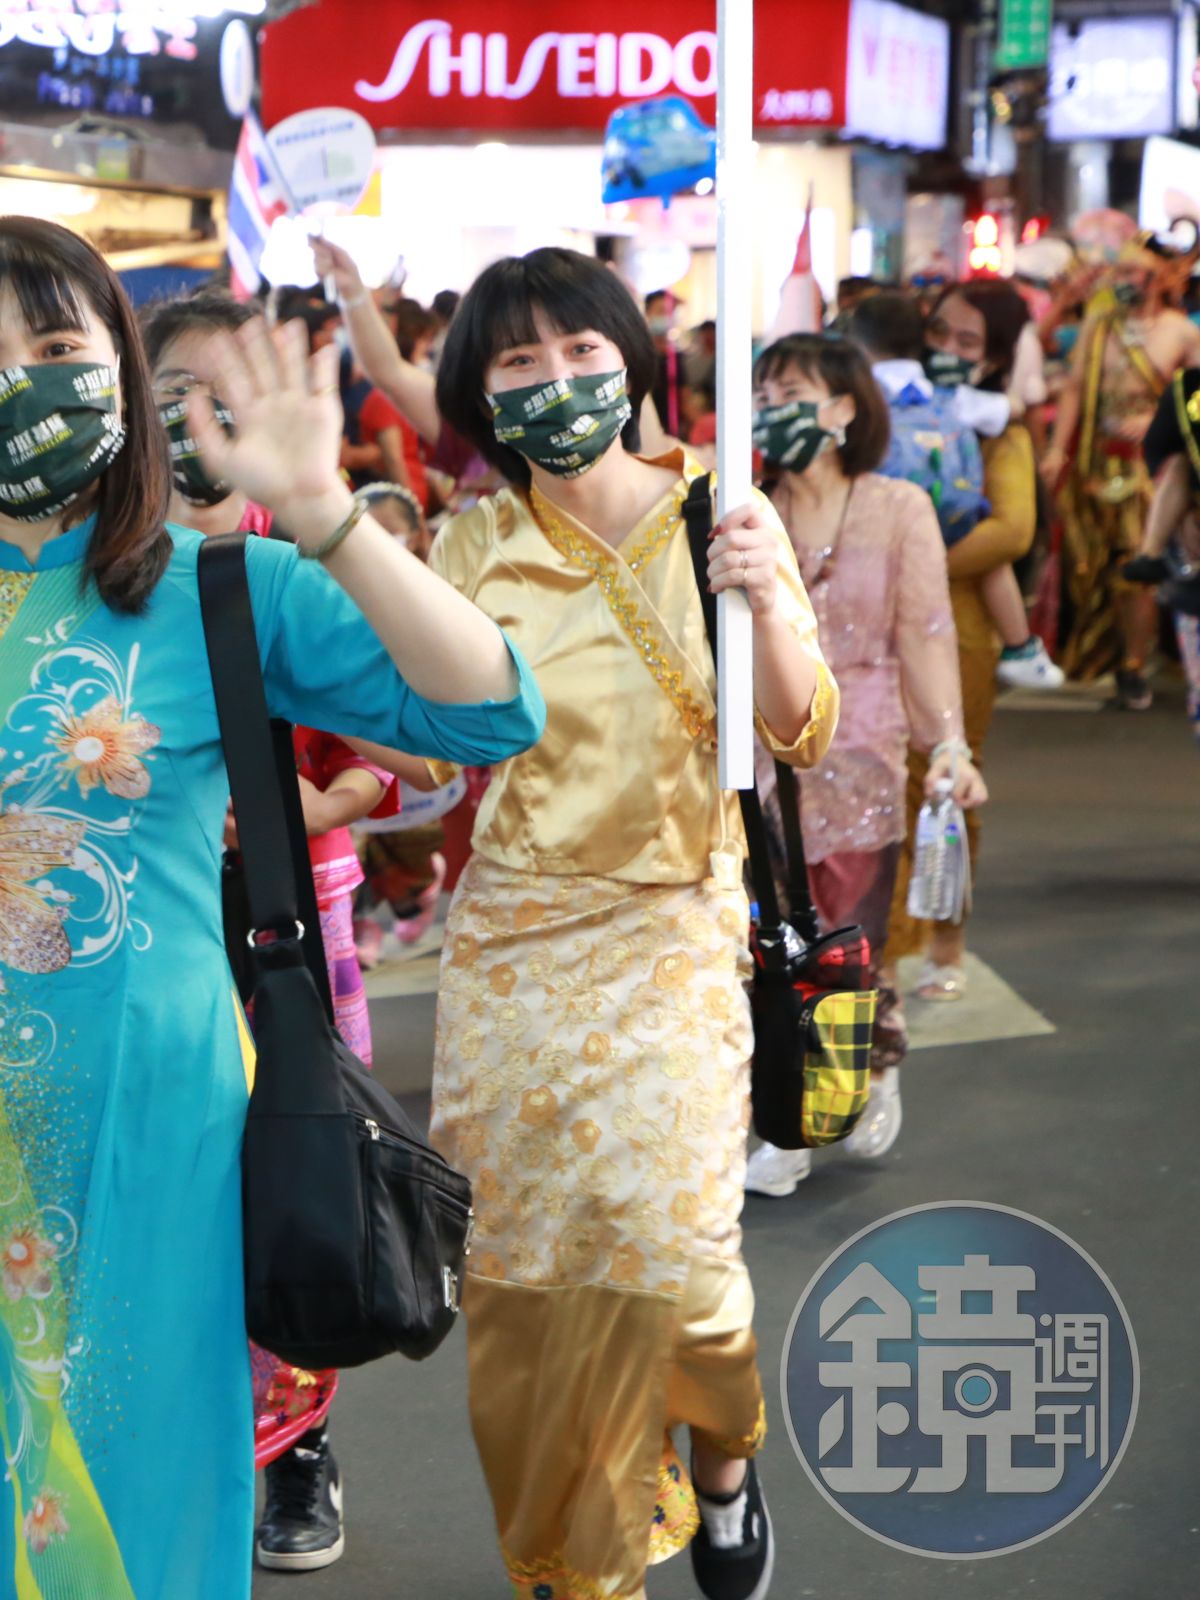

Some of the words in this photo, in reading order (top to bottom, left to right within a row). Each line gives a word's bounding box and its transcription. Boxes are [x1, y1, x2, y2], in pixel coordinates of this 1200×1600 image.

[354, 19, 717, 101] SHISEIDO
[6, 413, 68, 456] #挺基隆
[11, 428, 73, 466] TEAMKEELUNG
